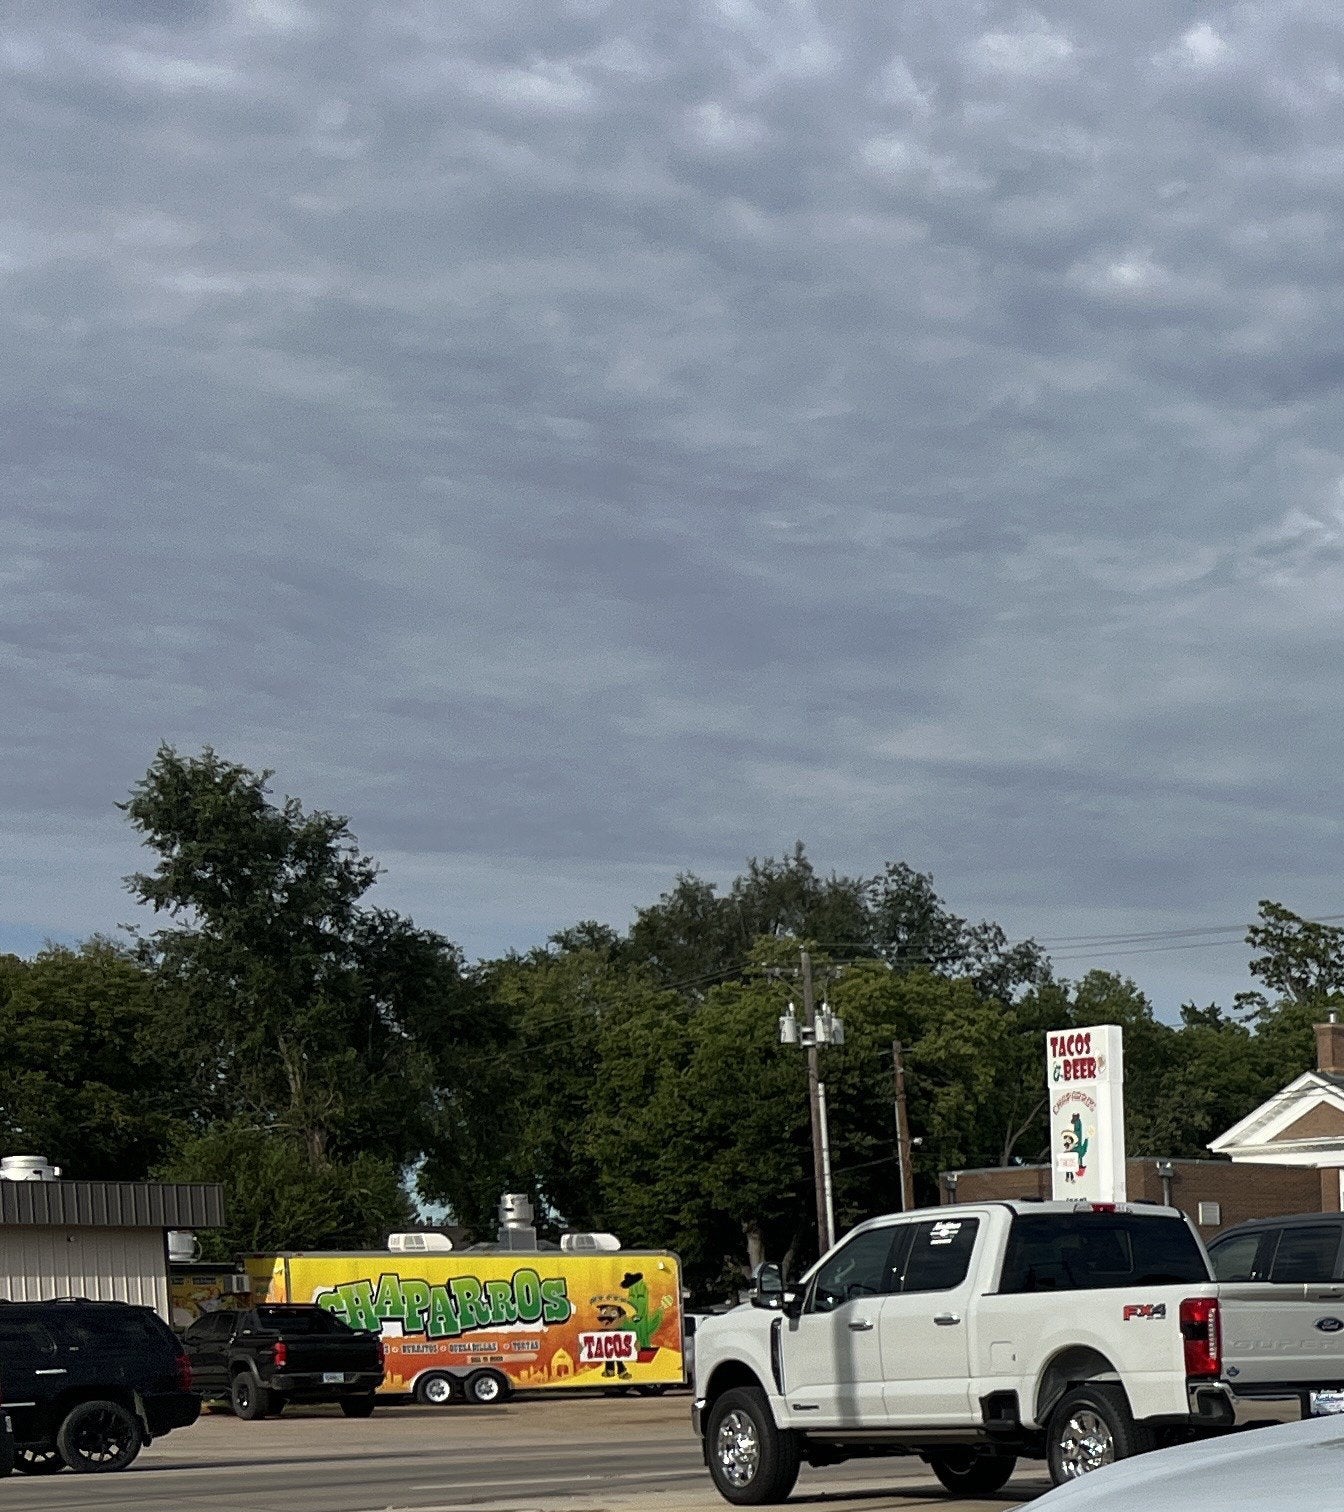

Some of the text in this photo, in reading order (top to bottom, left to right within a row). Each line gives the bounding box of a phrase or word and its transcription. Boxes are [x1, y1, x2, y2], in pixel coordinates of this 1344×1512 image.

[1050, 1032, 1091, 1058] TACOS
[1063, 1057, 1096, 1081] BEER
[317, 1268, 572, 1341] CHAPARROS
[1123, 1303, 1166, 1321] FX4
[583, 1333, 633, 1359] TACOS
